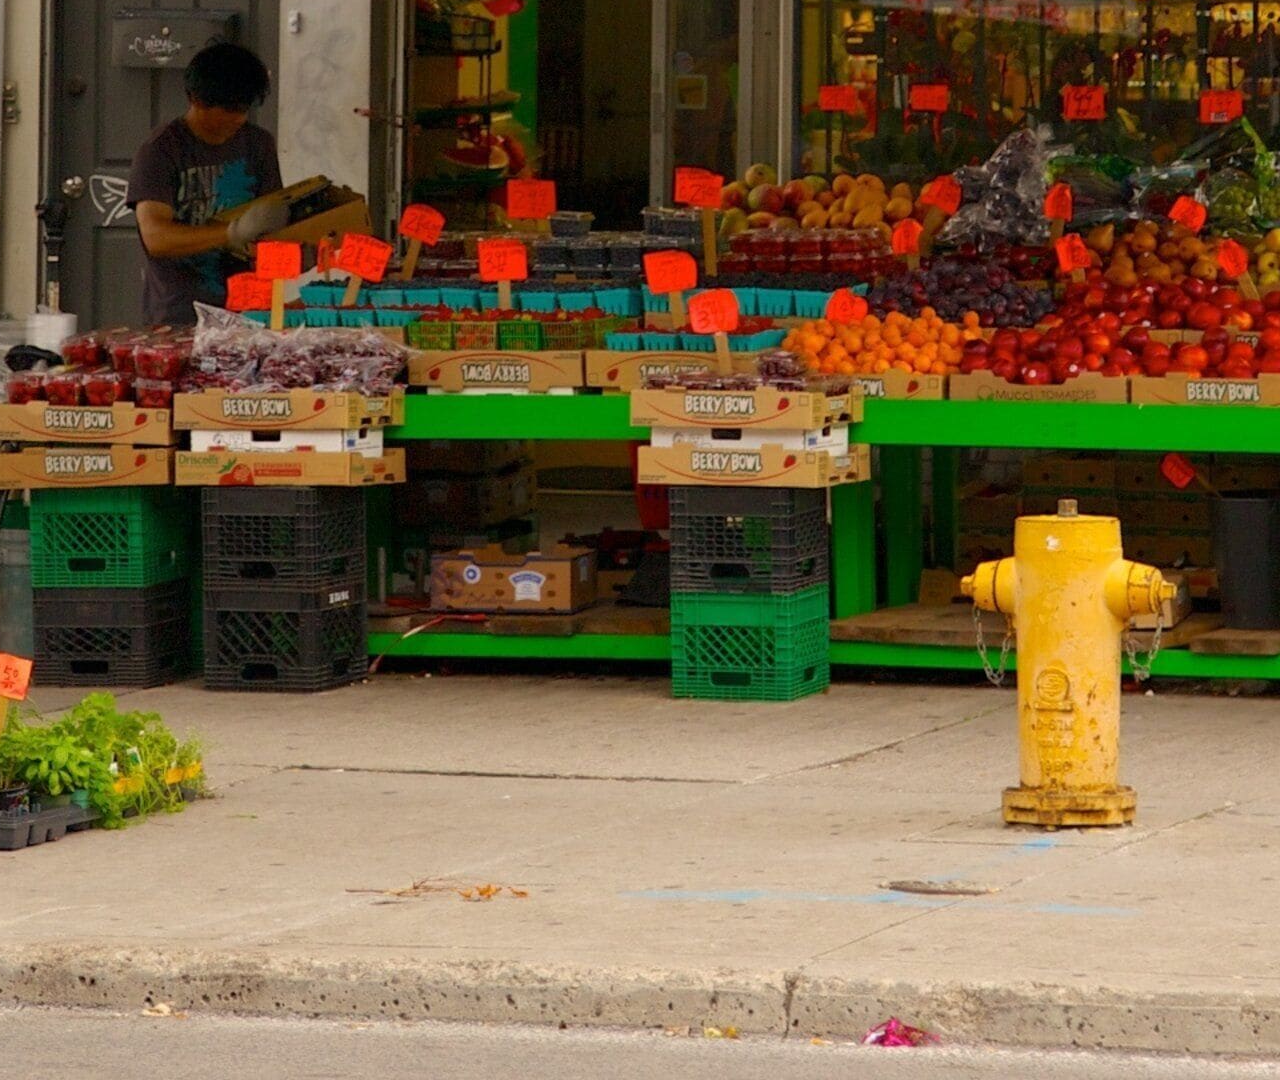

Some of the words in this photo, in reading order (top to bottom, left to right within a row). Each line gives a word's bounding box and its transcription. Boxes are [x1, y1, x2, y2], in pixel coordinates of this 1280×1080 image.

[1187, 382, 1225, 401] BERRY
[1227, 383, 1260, 402] BOWL
[222, 398, 258, 417] BERRY
[261, 397, 292, 416] BOWL
[685, 395, 723, 415] BERRY
[724, 395, 756, 415] BOWL
[45, 409, 81, 429] BERRY
[83, 410, 115, 430] BOWL
[45, 455, 81, 474] BERRY
[83, 454, 114, 474] BOWL
[692, 451, 729, 472] BERRY
[731, 451, 763, 473] BOWL
